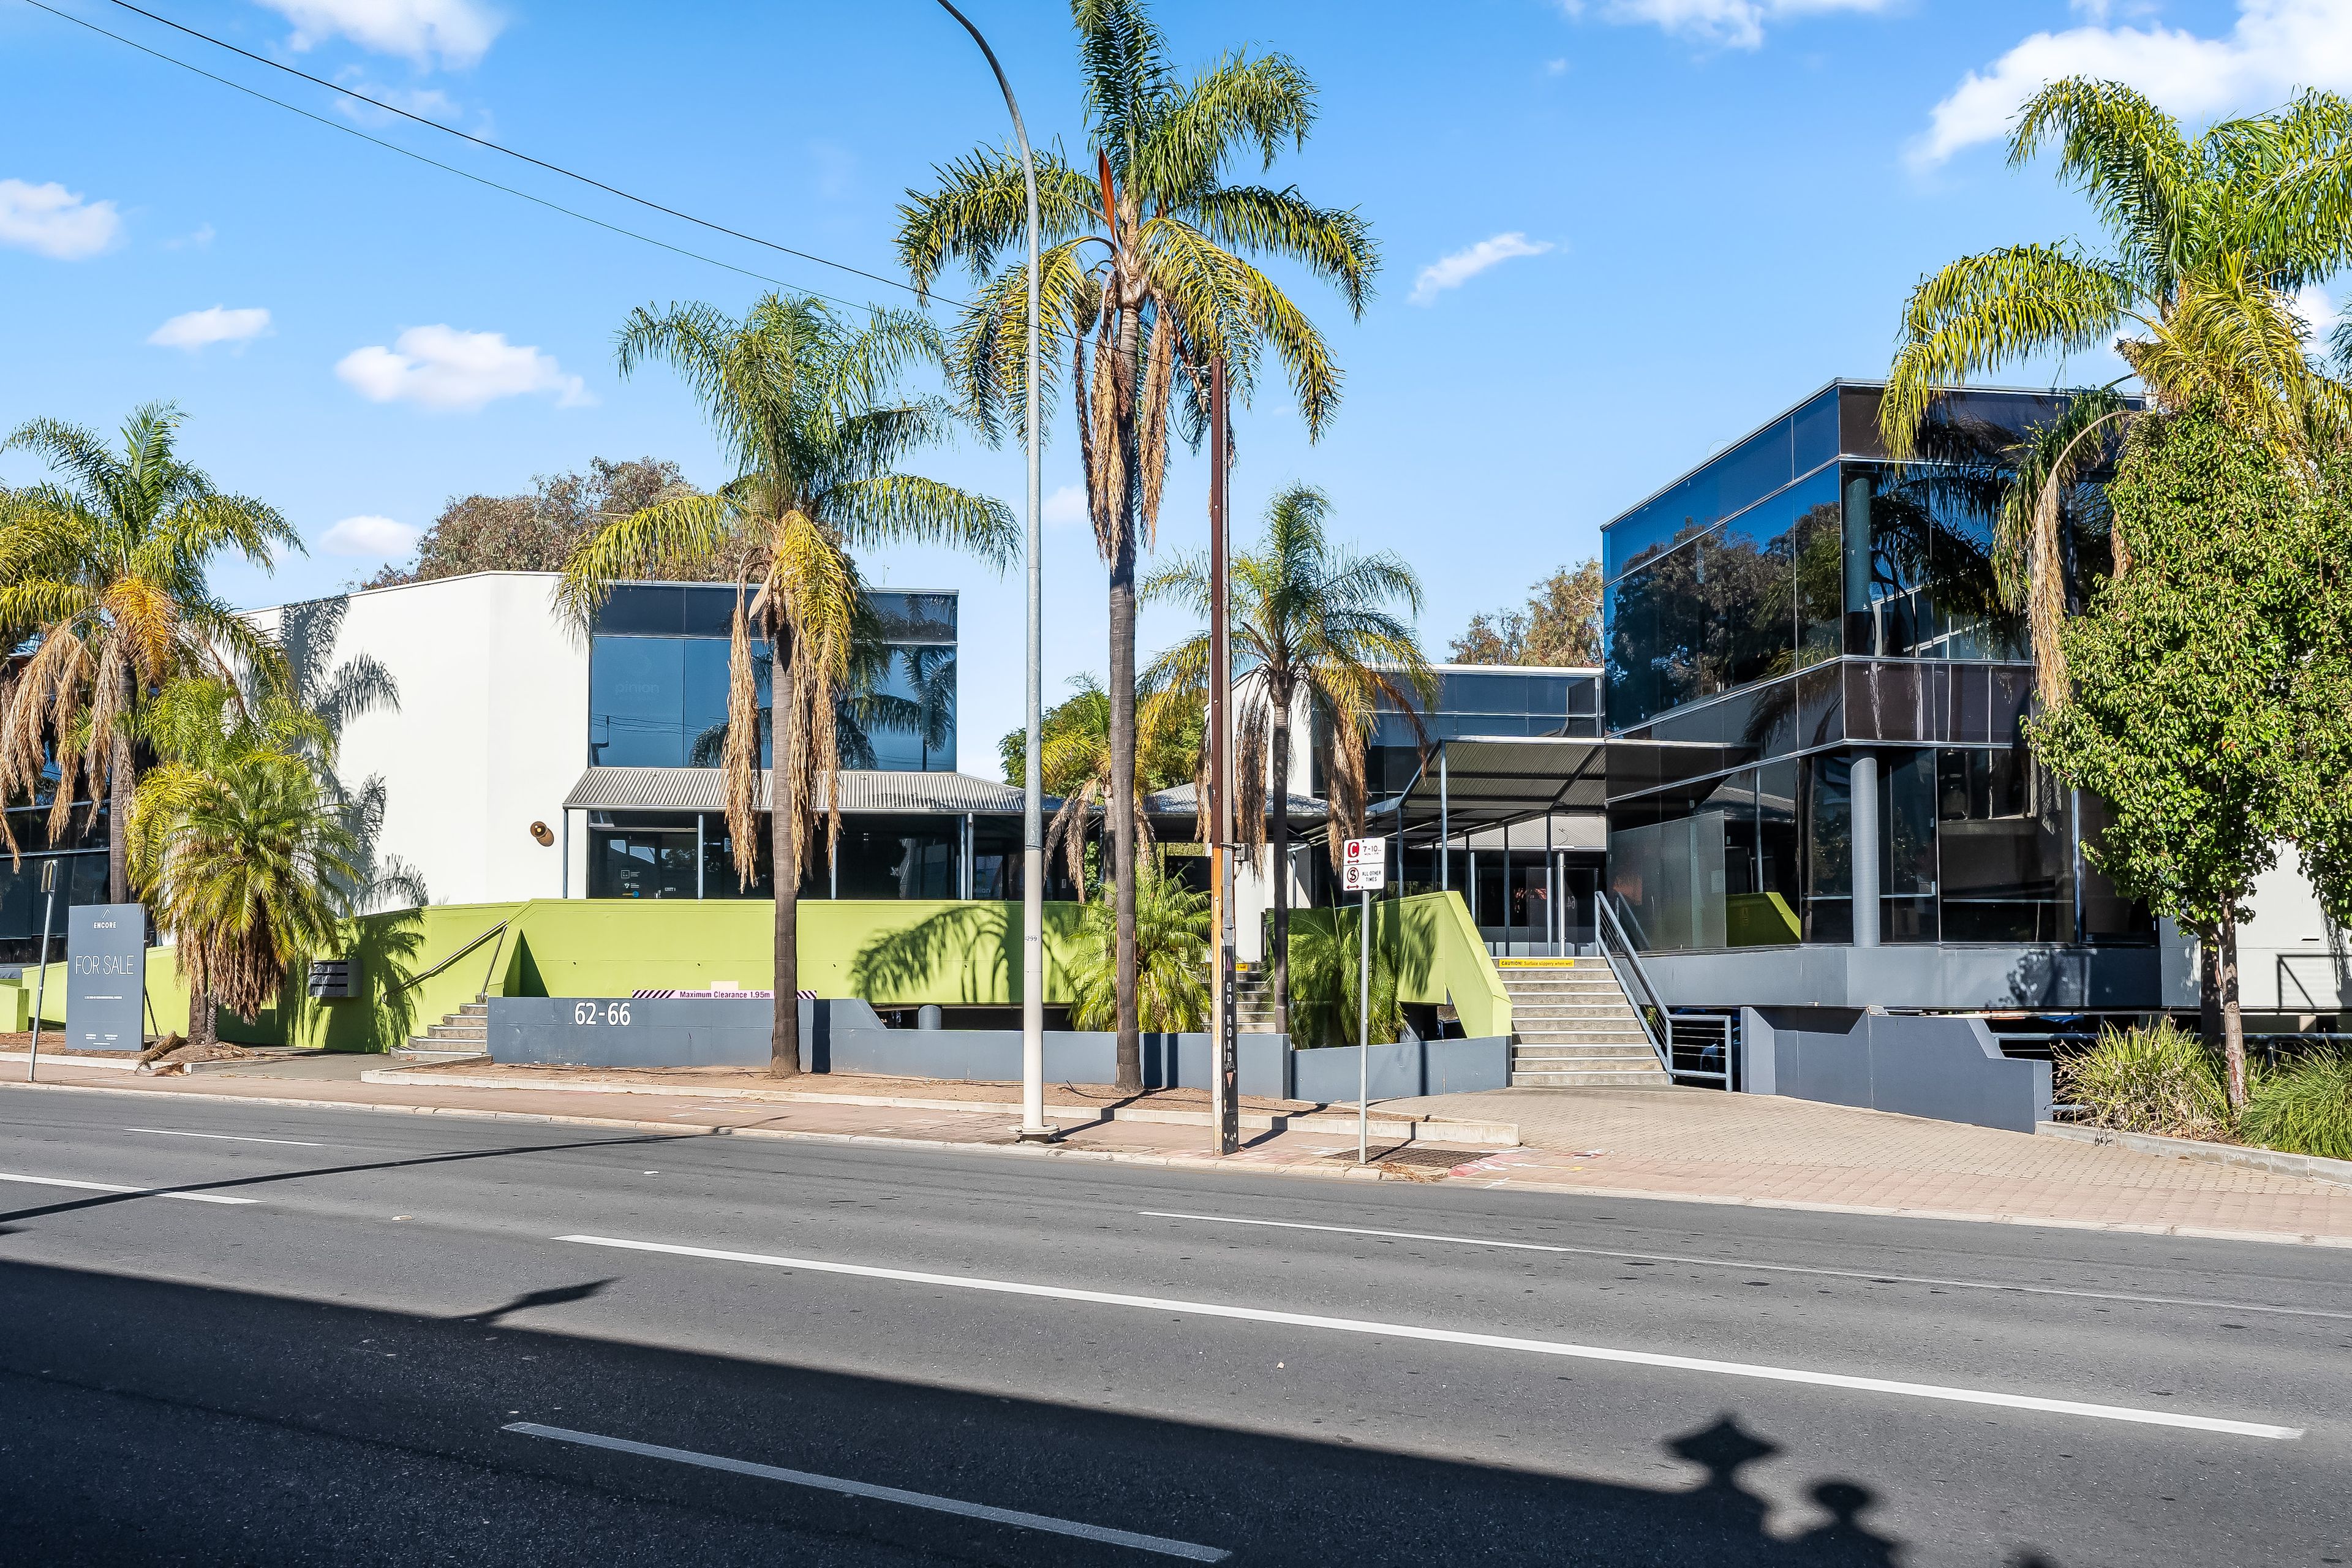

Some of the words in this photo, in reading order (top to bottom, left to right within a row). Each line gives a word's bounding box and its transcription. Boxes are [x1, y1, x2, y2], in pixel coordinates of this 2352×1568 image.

[615, 680, 660, 695] pinion
[75, 955, 100, 975] FOR
[103, 954, 135, 975] SALE
[1226, 982, 1232, 1005] GO
[574, 1001, 631, 1027] 62-66
